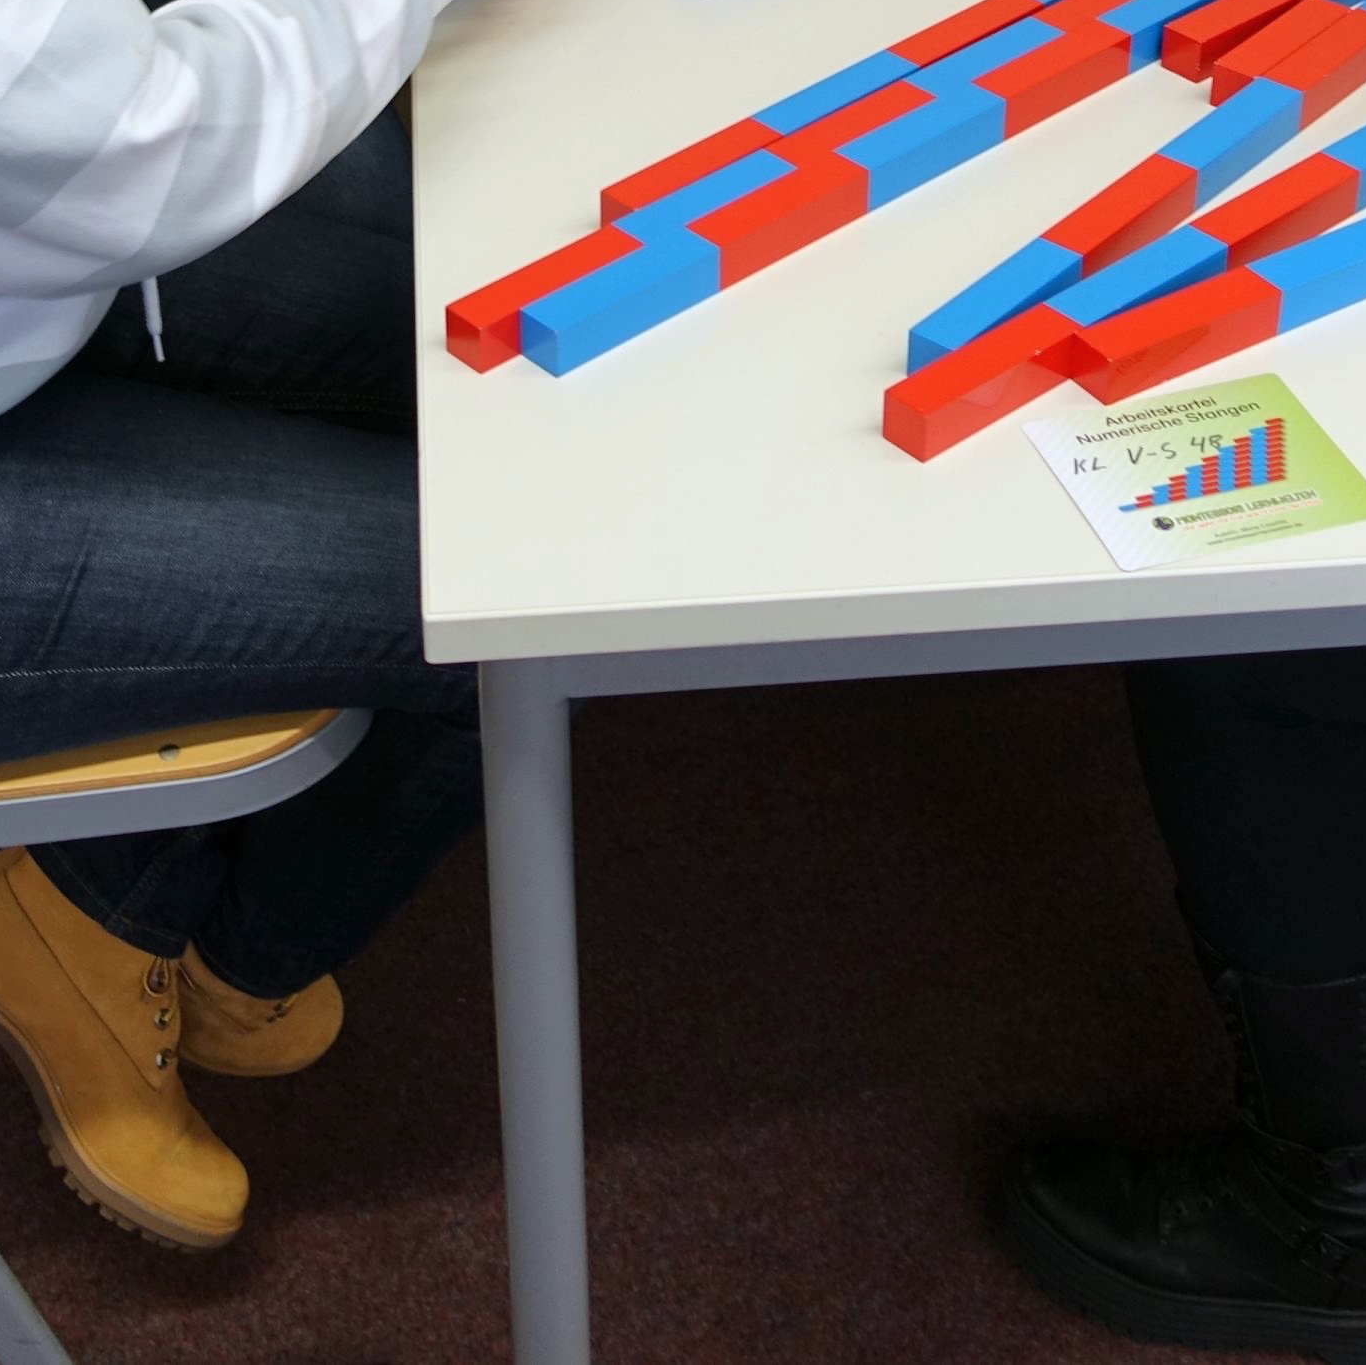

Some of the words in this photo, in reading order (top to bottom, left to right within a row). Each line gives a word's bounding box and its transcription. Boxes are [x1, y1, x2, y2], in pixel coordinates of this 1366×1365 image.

[1075, 417, 1183, 445] Numerische
[1186, 401, 1261, 423] Stangen
[1105, 396, 1217, 426] Arbeitskartei
[1073, 456, 1107, 474] KL
[1126, 442, 1177, 465] V-S
